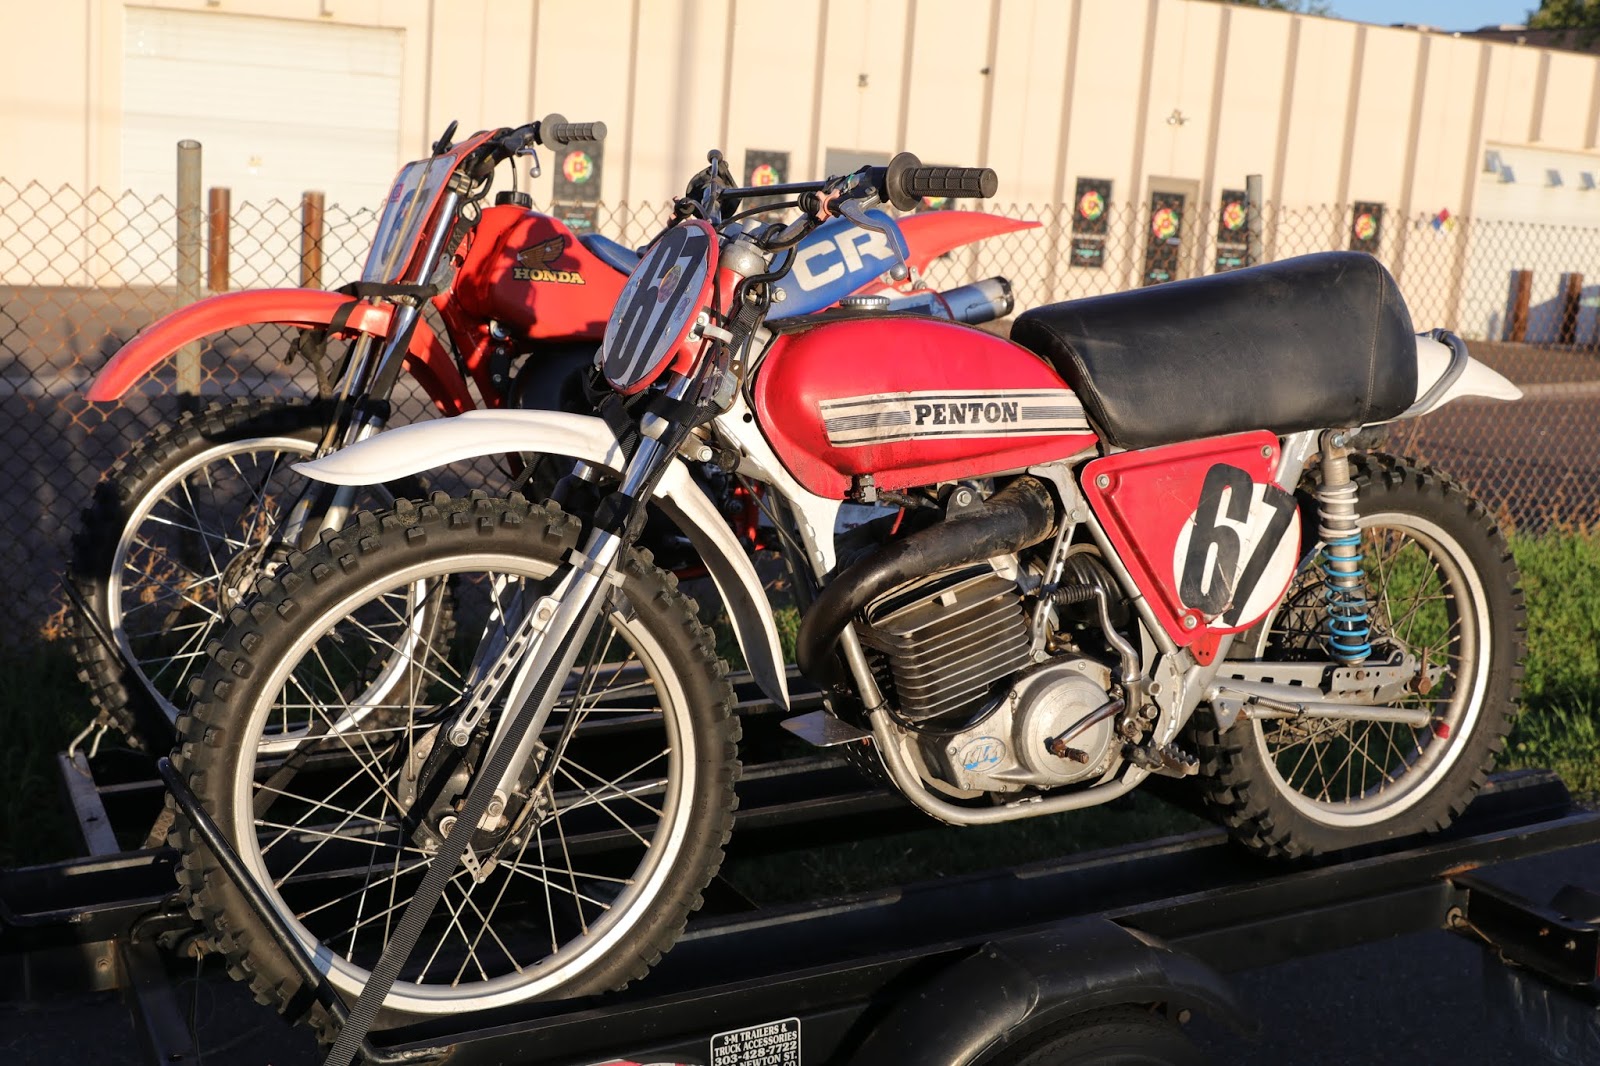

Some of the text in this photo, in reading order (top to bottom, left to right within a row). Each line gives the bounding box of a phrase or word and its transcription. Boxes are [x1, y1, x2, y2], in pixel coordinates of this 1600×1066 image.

[791, 226, 895, 292] CR
[513, 267, 586, 285] HONDA
[602, 226, 710, 388] 67
[913, 401, 1019, 426] PENTON
[1179, 462, 1299, 628] 67
[714, 1030, 798, 1058] TRUCK ACCESSORIES
[724, 1023, 788, 1046] 3-M TRAILERS &
[714, 1040, 798, 1066] 303-428-7722
[783, 1050, 798, 1061] ST.
